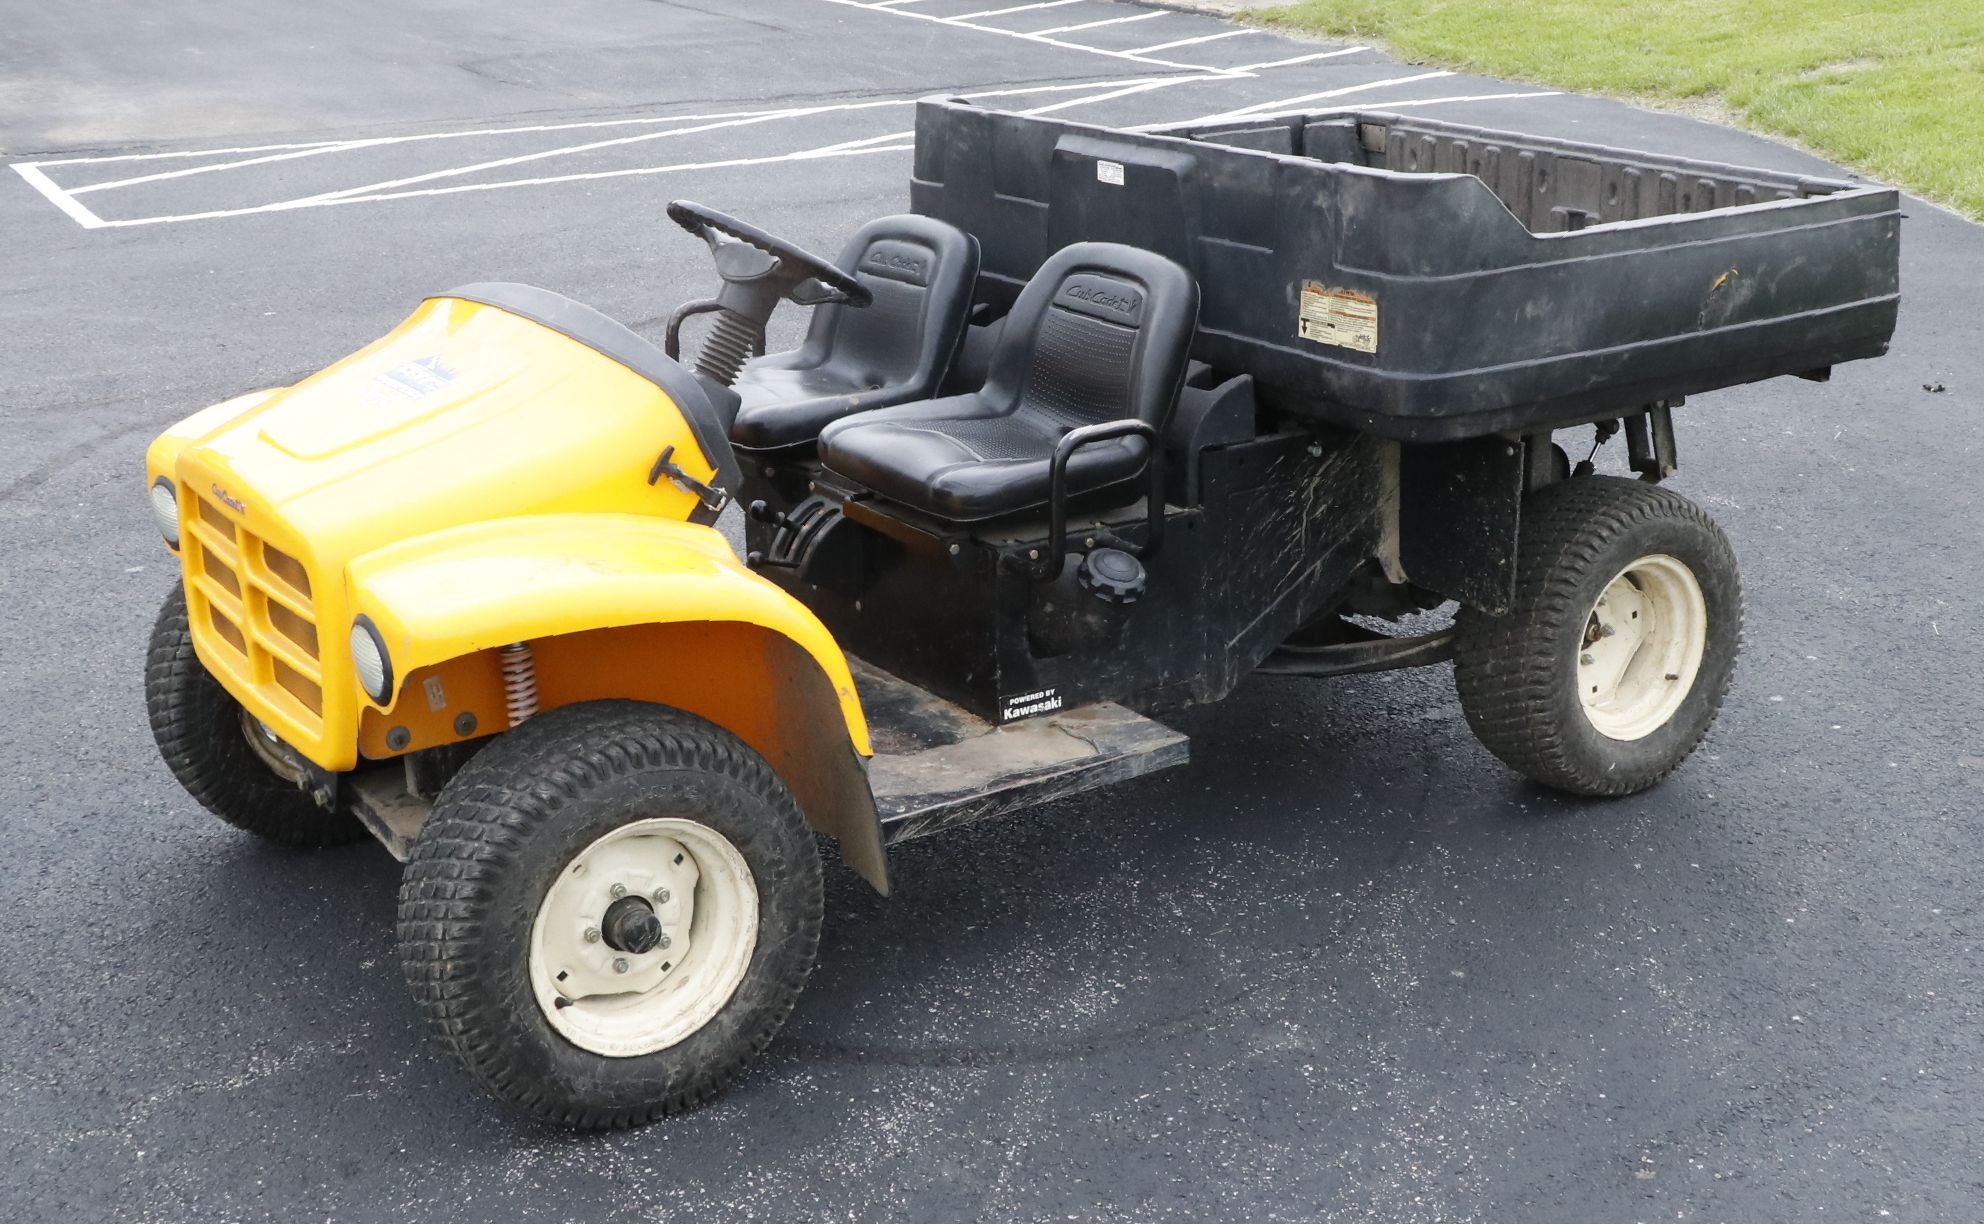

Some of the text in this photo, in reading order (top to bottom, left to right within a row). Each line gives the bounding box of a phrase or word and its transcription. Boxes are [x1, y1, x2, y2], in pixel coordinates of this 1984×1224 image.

[1003, 695, 1062, 720] Kawasaki
[1009, 688, 1056, 706] POWERED BY
